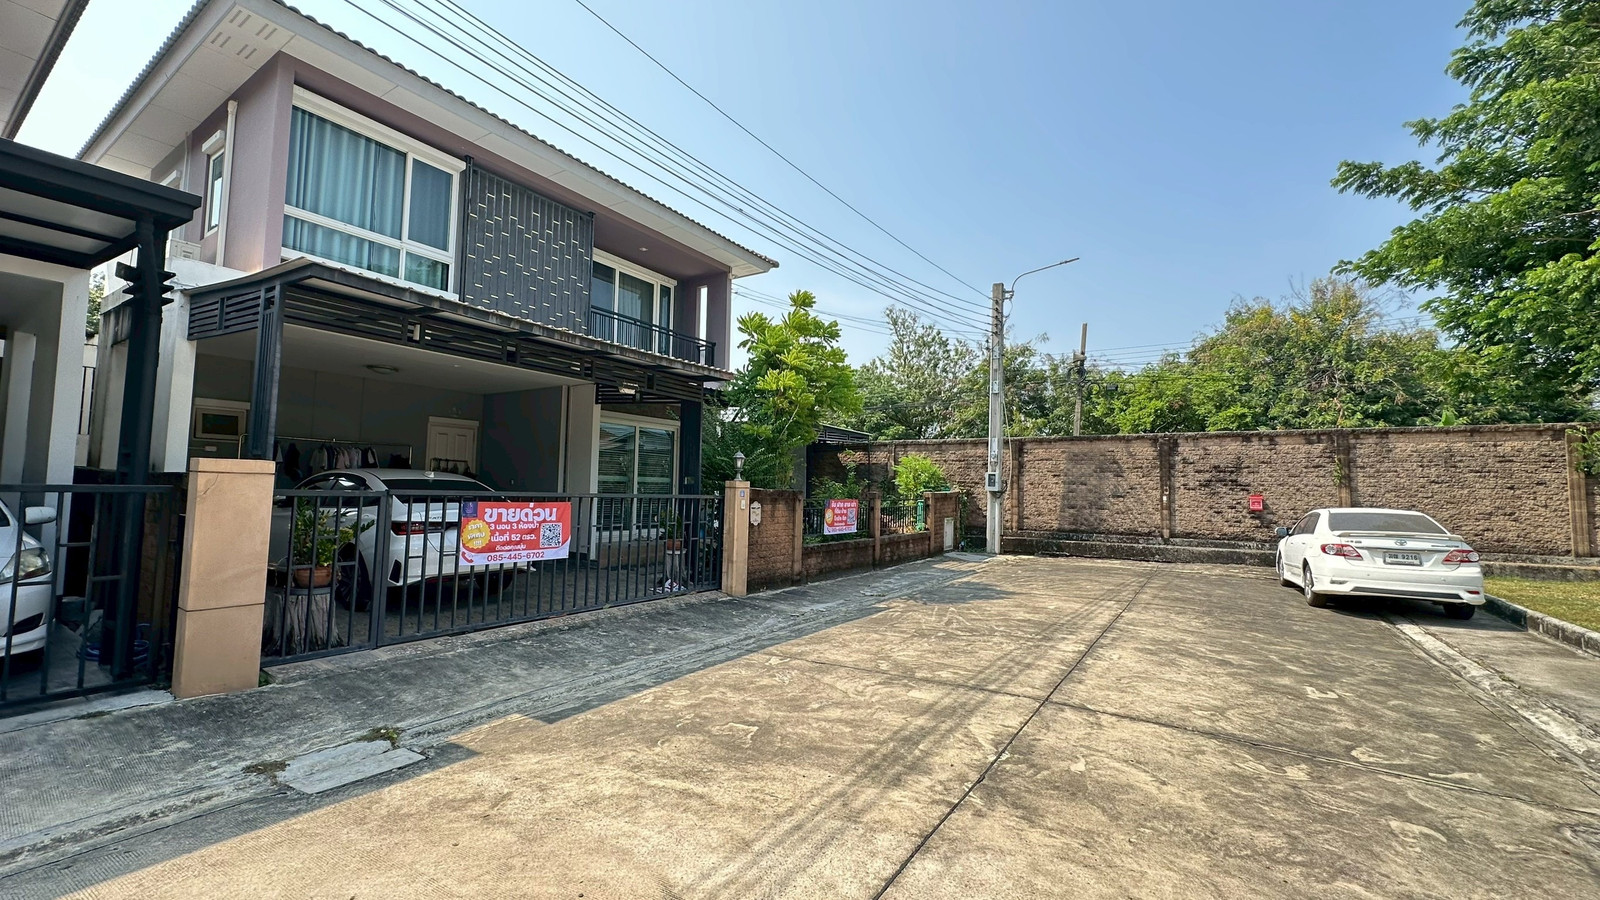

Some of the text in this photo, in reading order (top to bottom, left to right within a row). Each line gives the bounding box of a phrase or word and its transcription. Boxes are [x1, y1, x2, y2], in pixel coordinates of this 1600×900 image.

[484, 502, 557, 522] ขายด่วน
[518, 520, 539, 529] ห้องน้ำ
[491, 531, 510, 542] เนื้อที่
[487, 552, 544, 562] 085-445-6702
